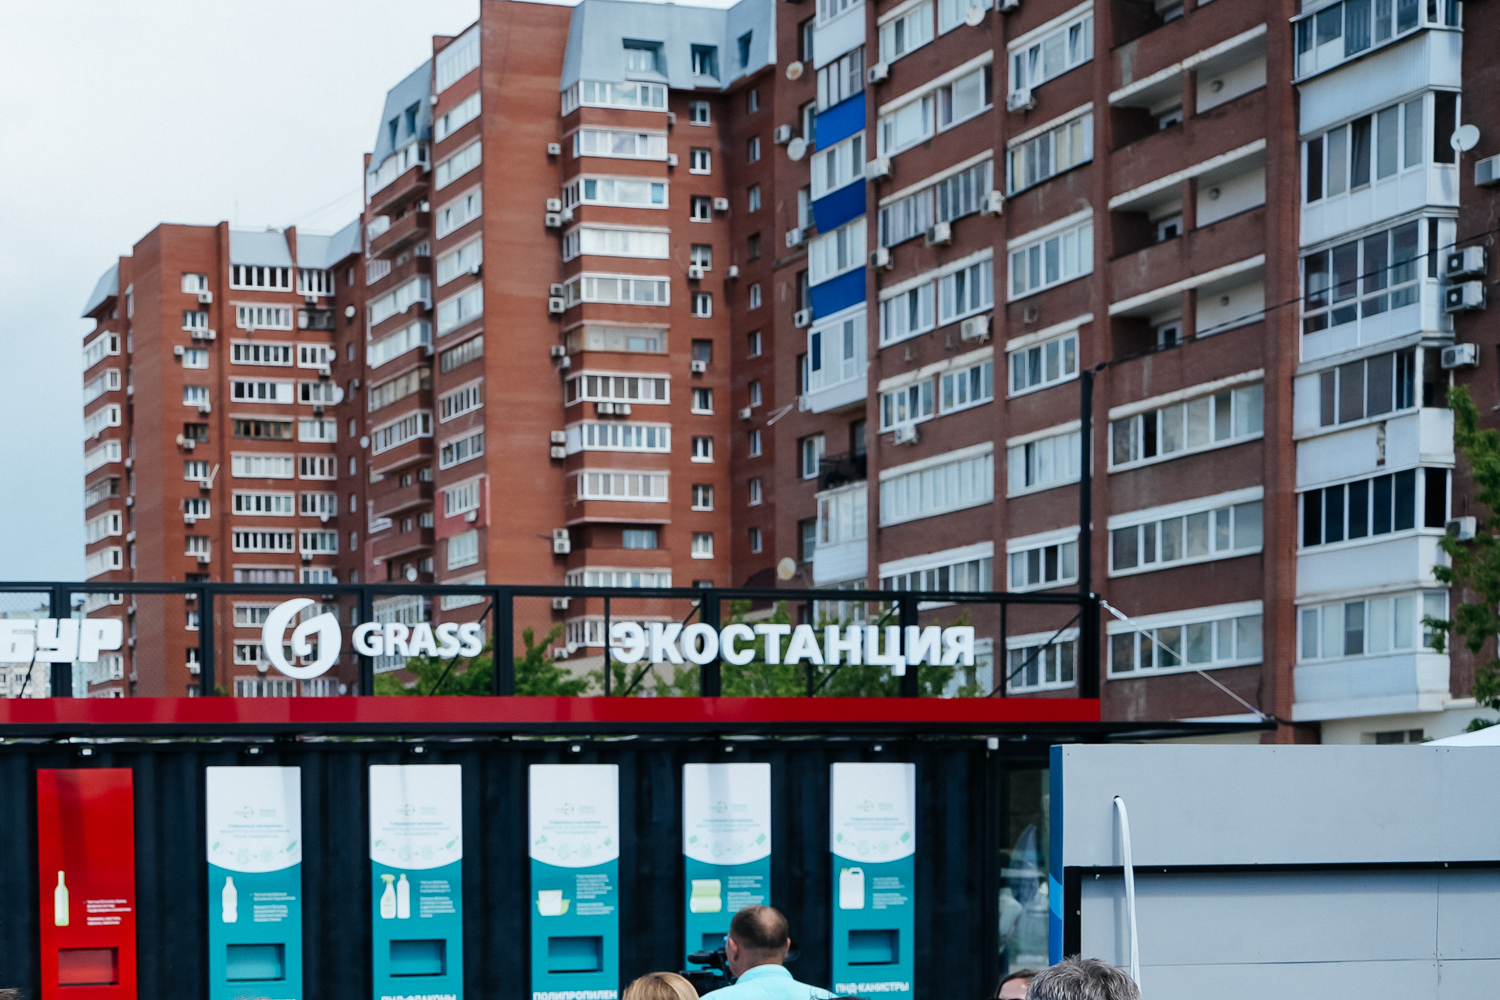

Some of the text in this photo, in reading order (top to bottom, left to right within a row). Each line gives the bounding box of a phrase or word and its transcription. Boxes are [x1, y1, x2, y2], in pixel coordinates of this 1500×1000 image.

[352, 621, 483, 658] GRASS
[609, 622, 975, 676] ЭКОСТАНЦИЯ
[835, 981, 910, 995] ПНД-КАНИСТРЫ
